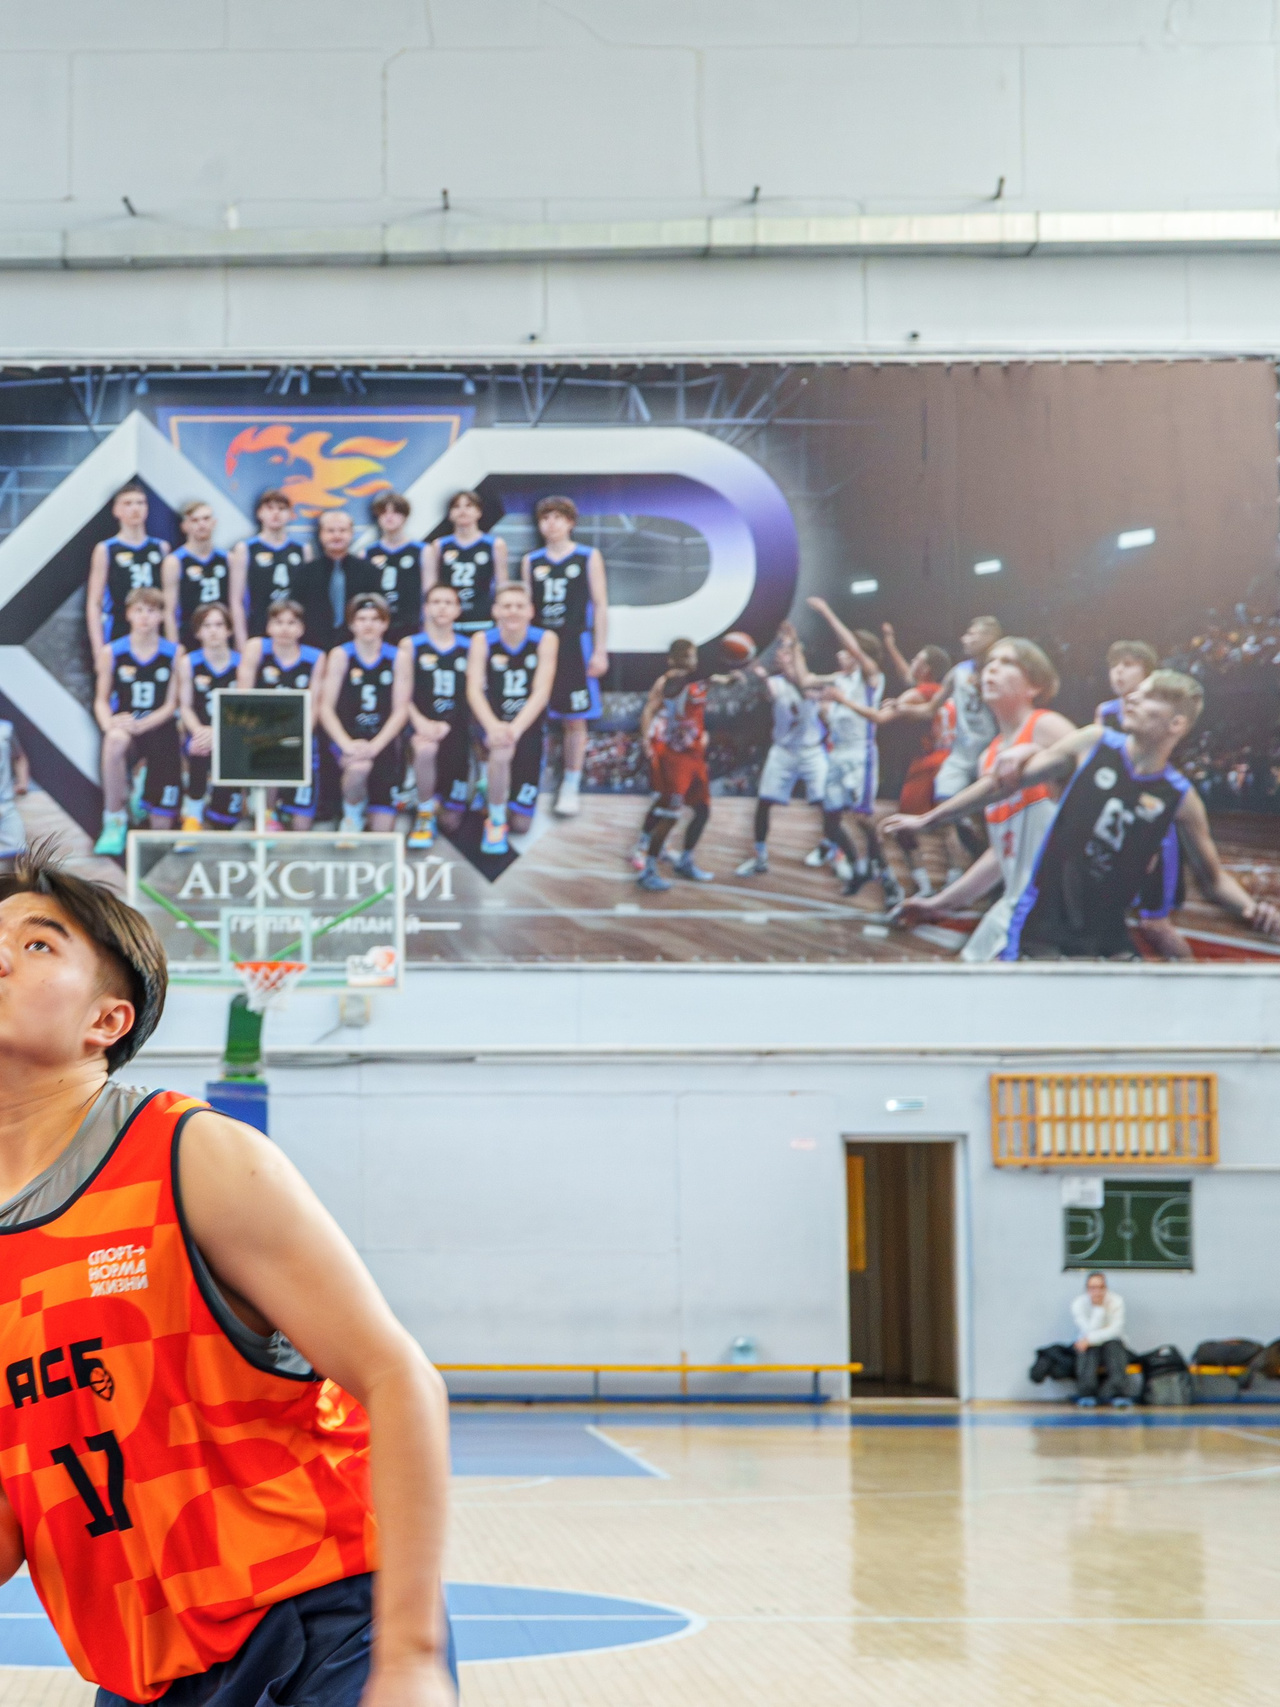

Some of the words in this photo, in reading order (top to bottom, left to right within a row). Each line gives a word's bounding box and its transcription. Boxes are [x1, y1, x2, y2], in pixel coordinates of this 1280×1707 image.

[451, 562, 476, 587] 22
[543, 578, 568, 602] 15
[502, 669, 528, 697] 12
[361, 684, 377, 711] 5
[176, 855, 456, 901] АРХСТРОЙ
[231, 914, 306, 934] ГРППА
[310, 913, 421, 935] КМПАНЙ
[88, 1244, 134, 1266] СПОРТ
[88, 1258, 147, 1282] НОРМА
[90, 1274, 149, 1297] ЖИЗНИ
[6, 1337, 107, 1409] АСБ
[49, 1429, 134, 1538] 17
